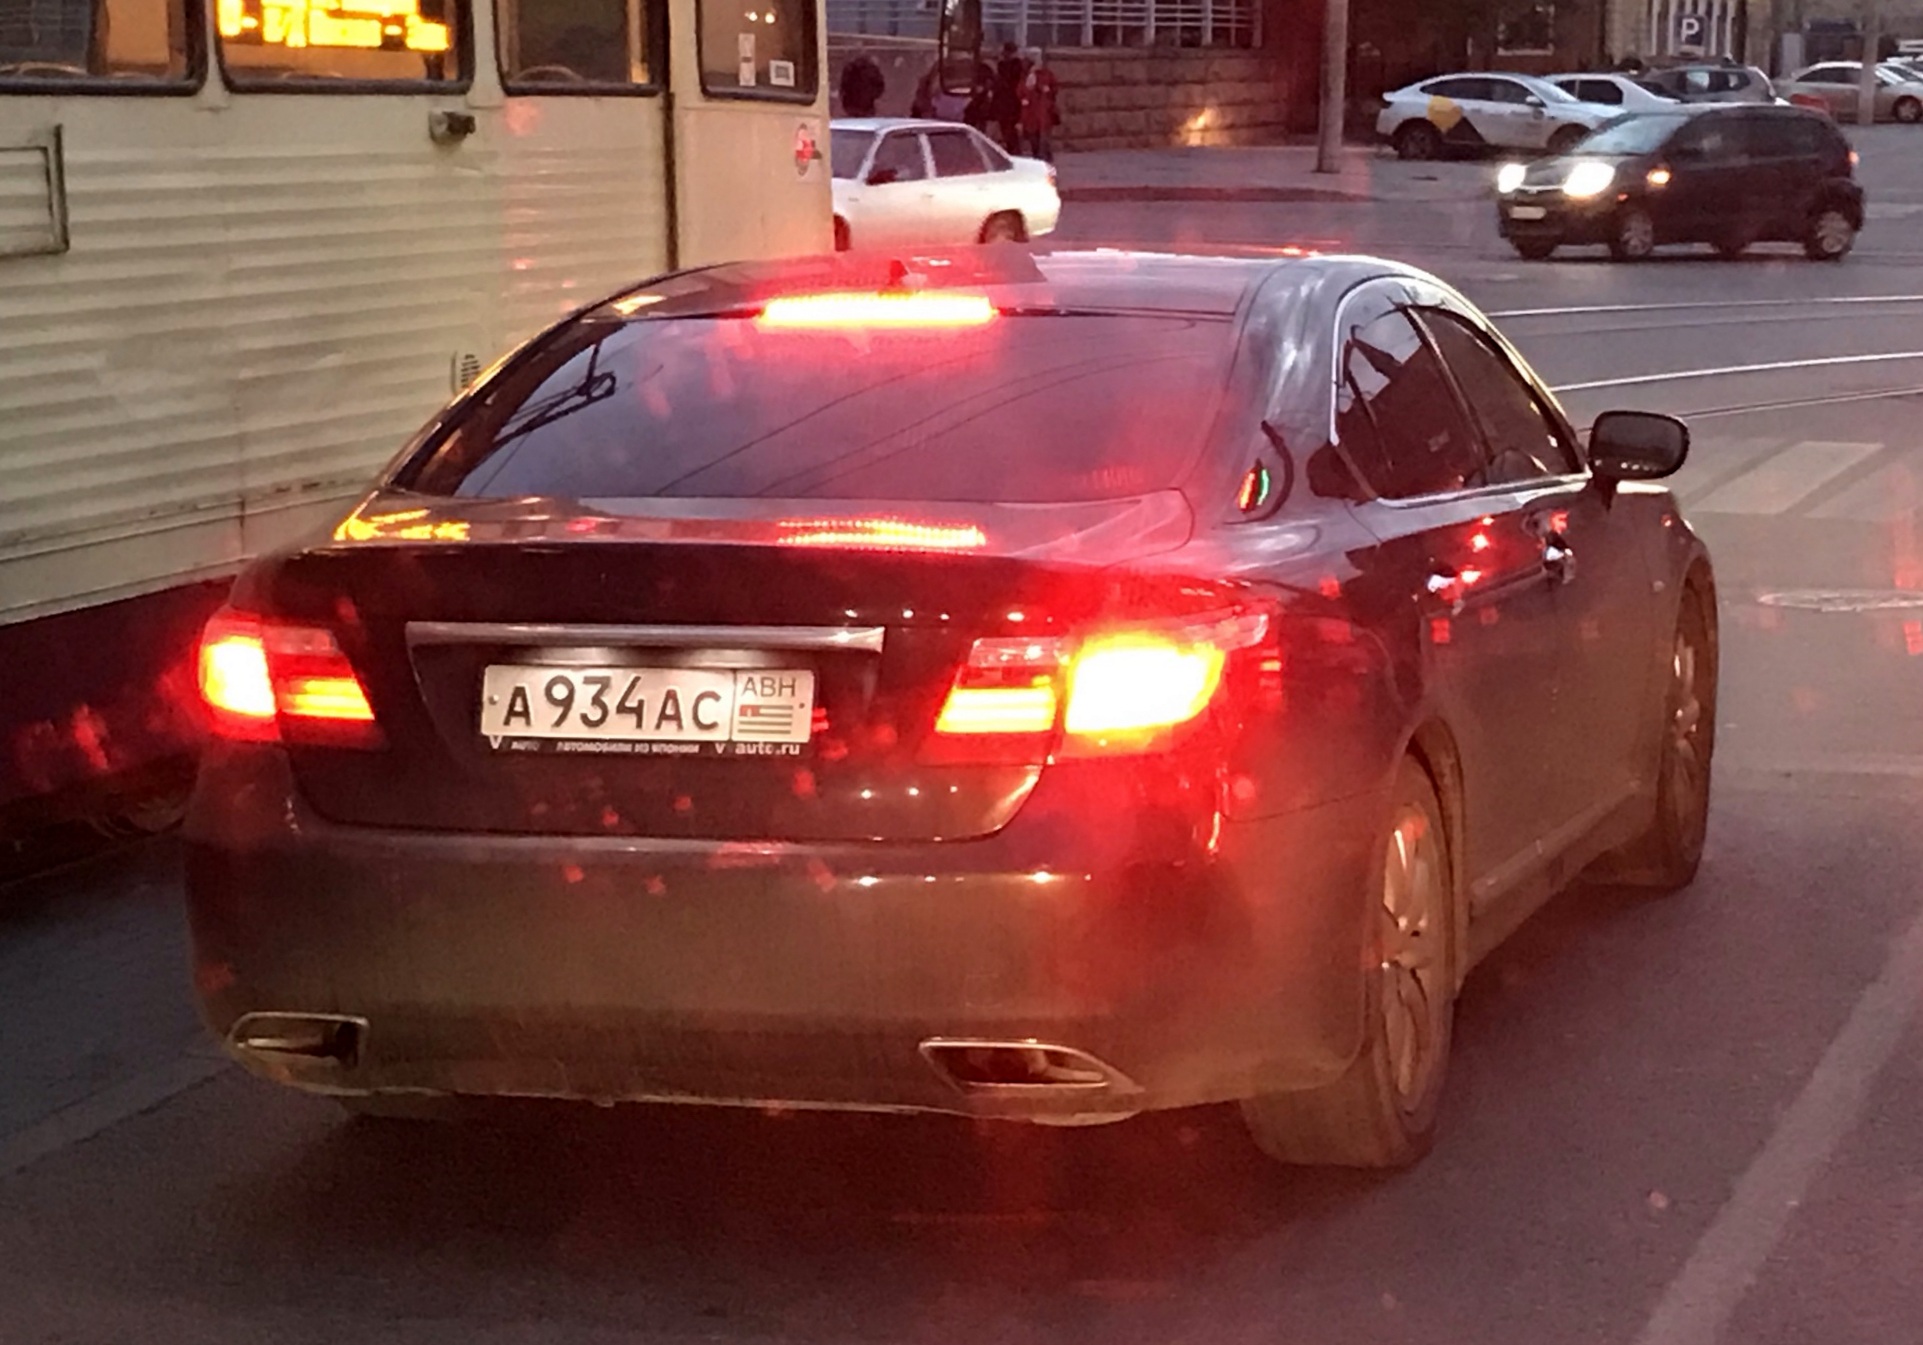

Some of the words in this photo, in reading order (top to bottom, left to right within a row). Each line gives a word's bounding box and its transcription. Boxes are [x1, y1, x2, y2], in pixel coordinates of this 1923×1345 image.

[1681, 18, 1700, 43] P
[741, 676, 796, 698] ABH
[503, 674, 721, 731] A934AC
